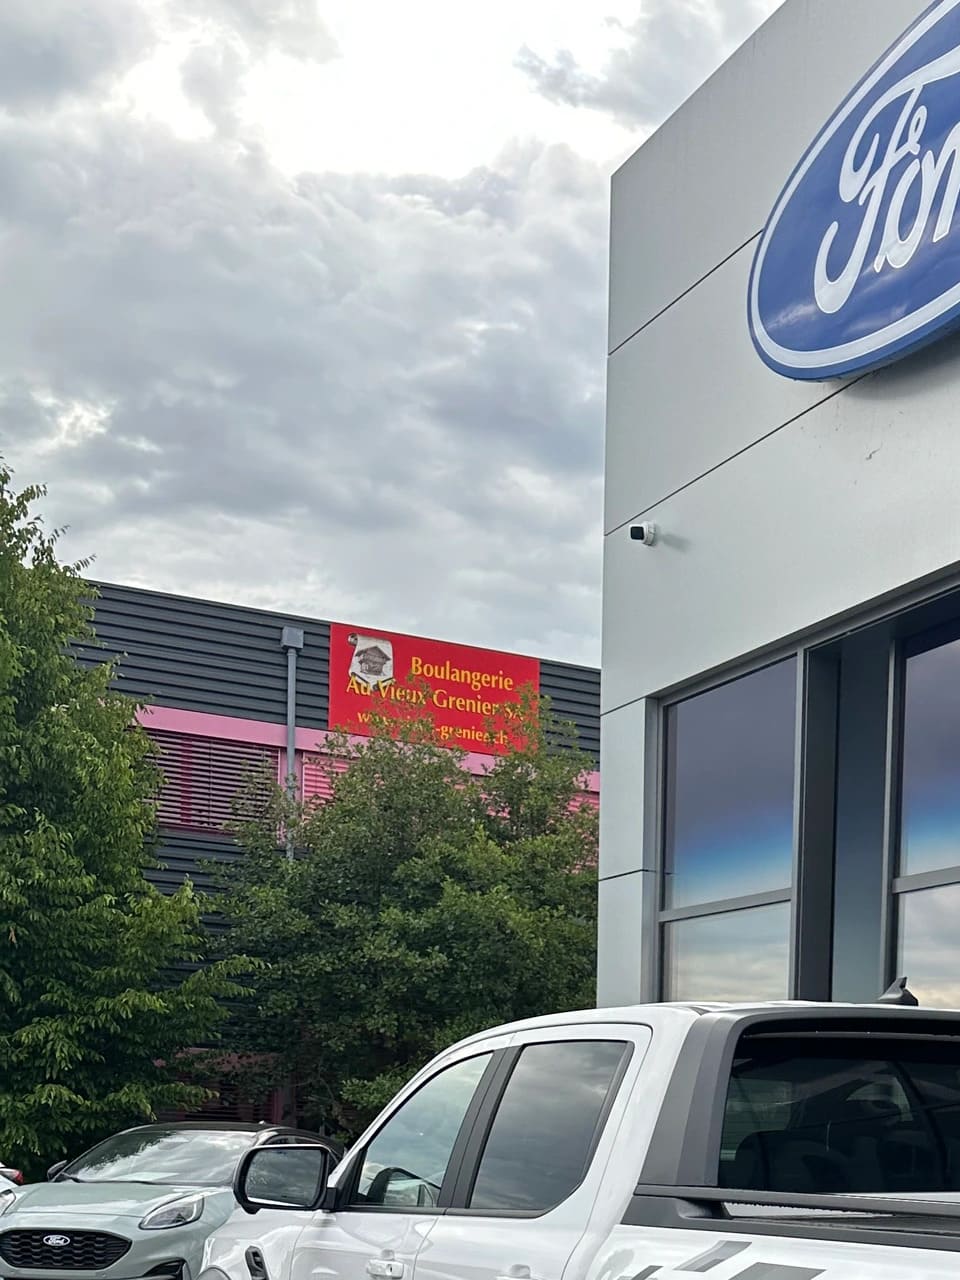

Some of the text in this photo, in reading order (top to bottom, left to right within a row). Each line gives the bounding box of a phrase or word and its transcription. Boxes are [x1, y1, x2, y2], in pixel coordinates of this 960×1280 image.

[411, 656, 514, 692] Boulangerie
[346, 676, 371, 696] Au
[377, 679, 427, 705] Vieux
[433, 689, 500, 716] Grenier
